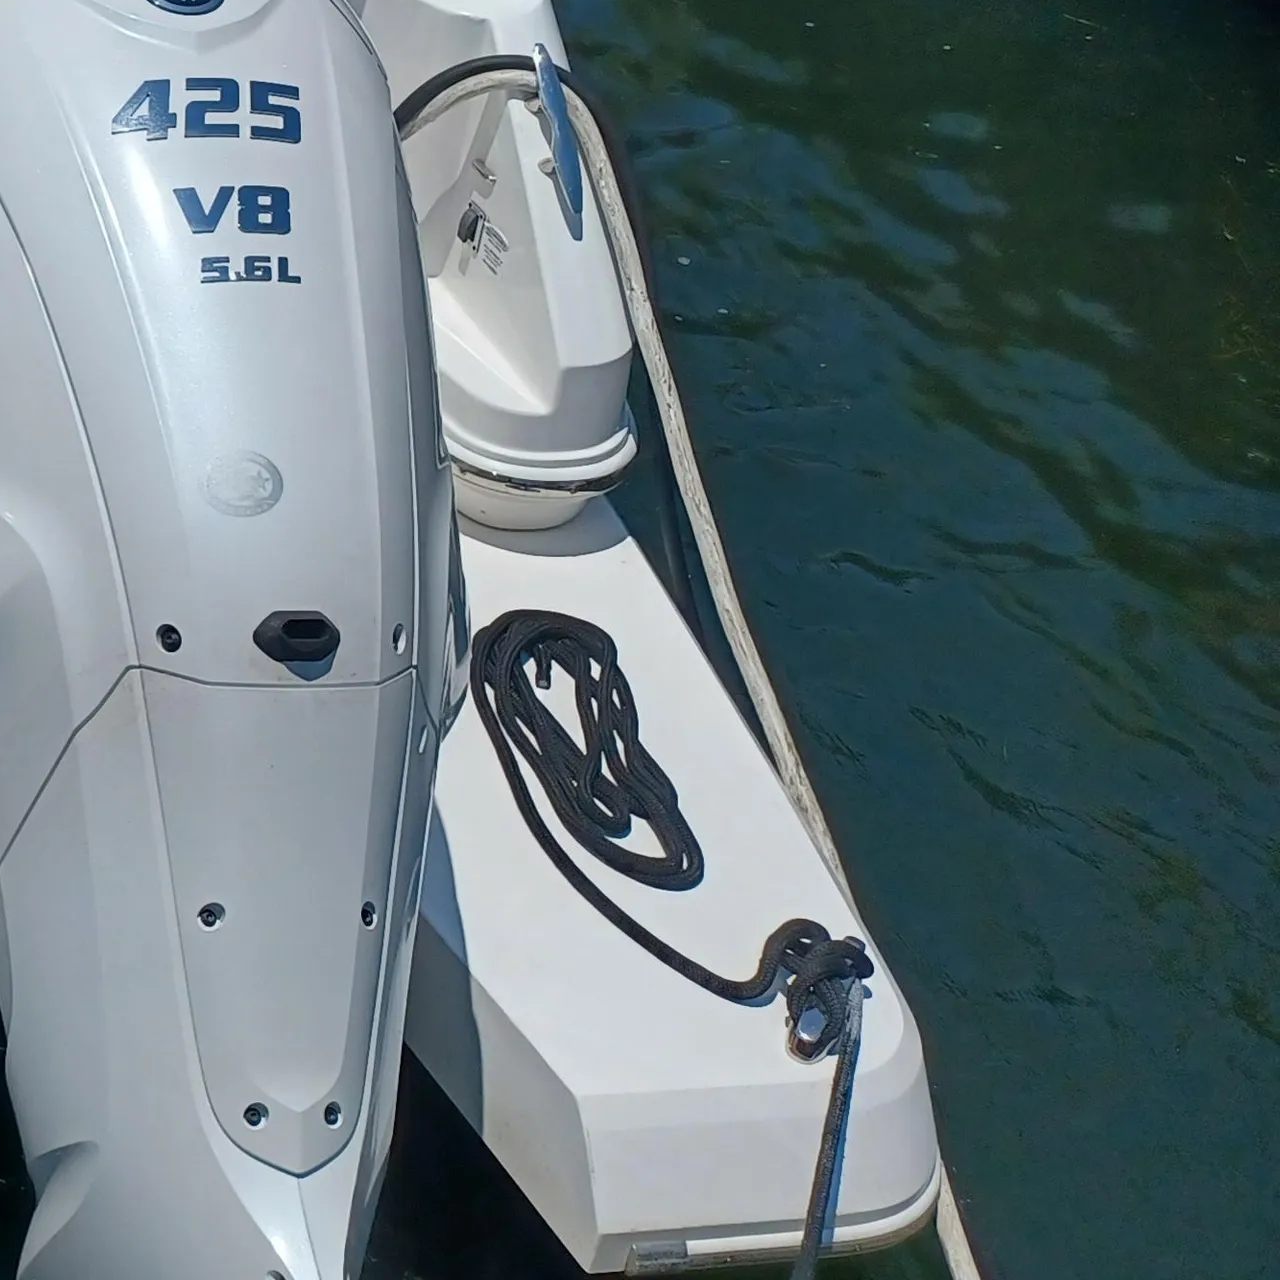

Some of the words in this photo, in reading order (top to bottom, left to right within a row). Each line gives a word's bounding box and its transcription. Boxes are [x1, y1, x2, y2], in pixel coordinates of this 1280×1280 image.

[110, 77, 302, 145] 425
[172, 184, 292, 236] V8
[199, 255, 302, 285] 5.6L
